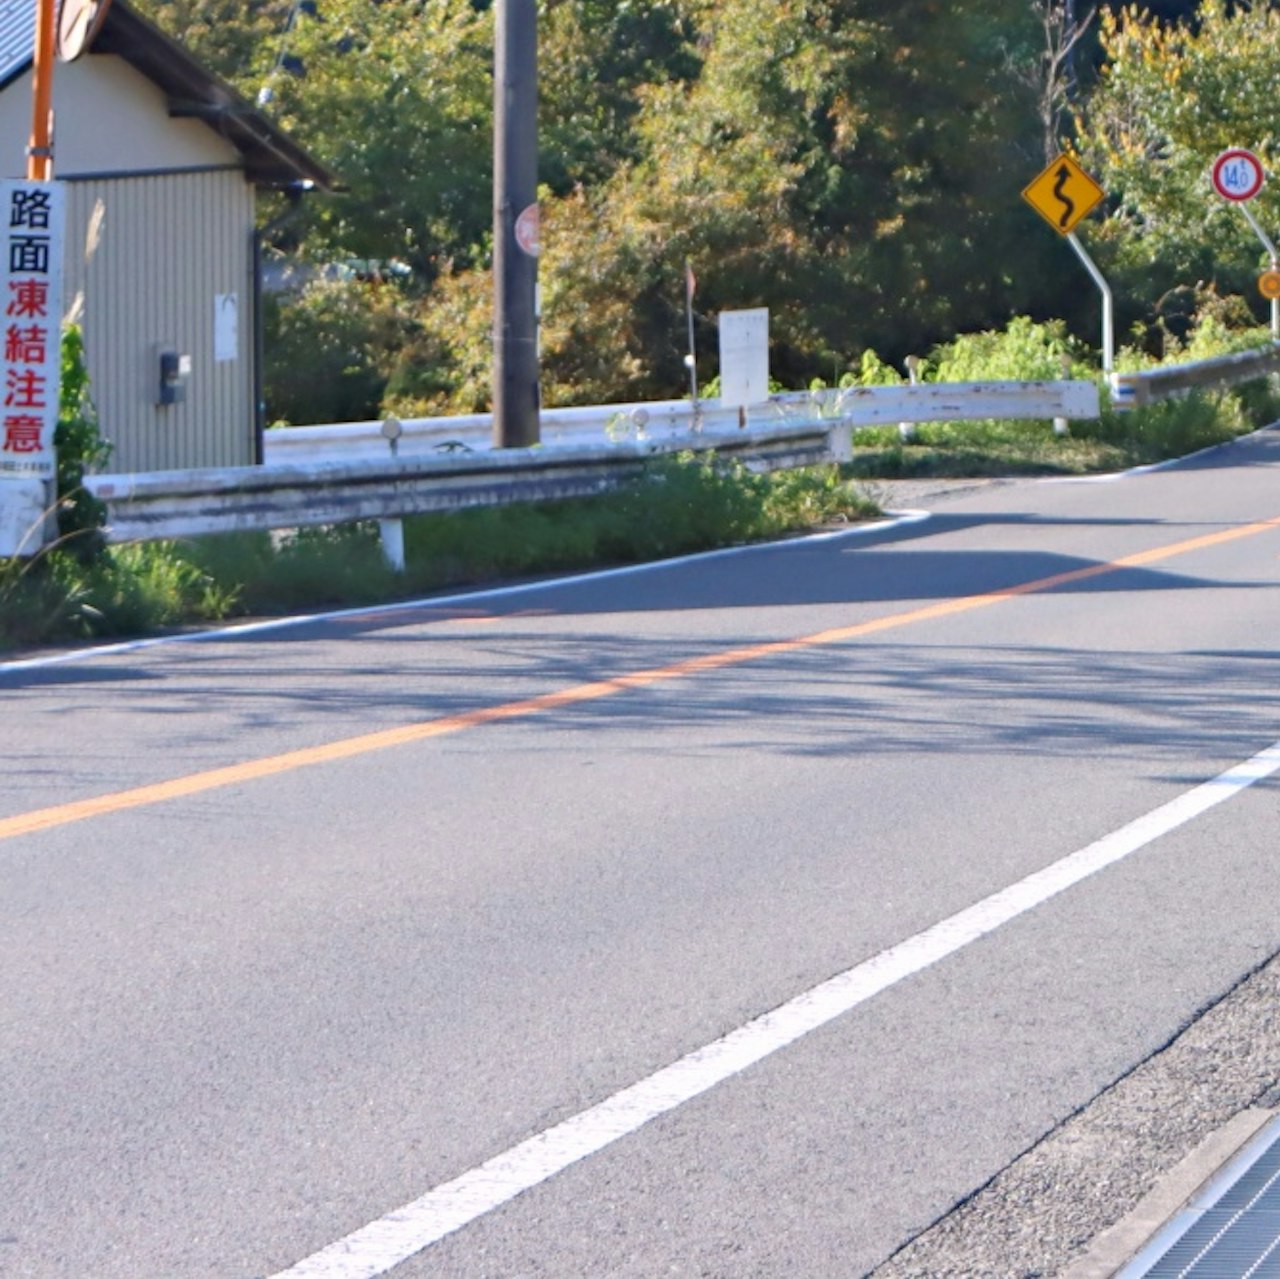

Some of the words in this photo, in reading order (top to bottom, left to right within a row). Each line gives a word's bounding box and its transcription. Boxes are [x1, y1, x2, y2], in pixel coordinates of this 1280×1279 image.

[3, 188, 51, 453] 路面凍結注意
